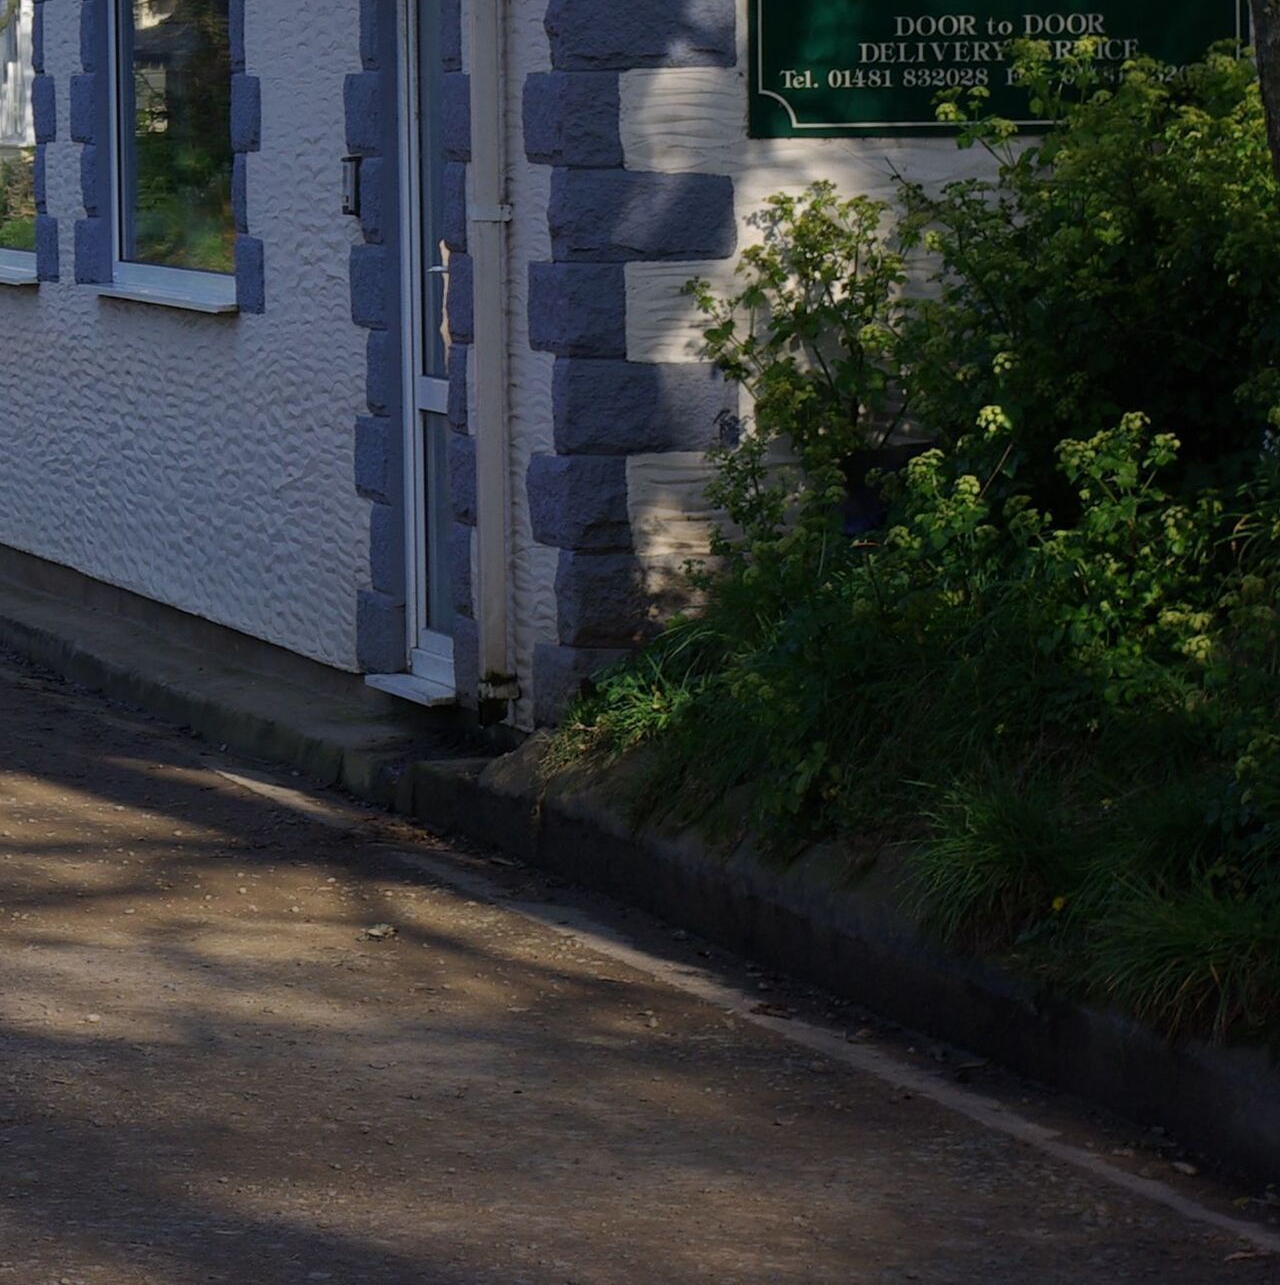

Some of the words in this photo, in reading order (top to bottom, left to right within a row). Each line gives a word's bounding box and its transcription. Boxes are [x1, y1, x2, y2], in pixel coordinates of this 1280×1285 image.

[895, 15, 977, 37] DOOR
[986, 18, 1013, 37] to
[1023, 13, 1105, 36] DOOR
[858, 40, 1008, 64] DELIVERY
[1022, 38, 1140, 61] RICE
[779, 69, 819, 90] Tel.
[827, 67, 893, 90] 01481
[903, 66, 989, 89] 832028
